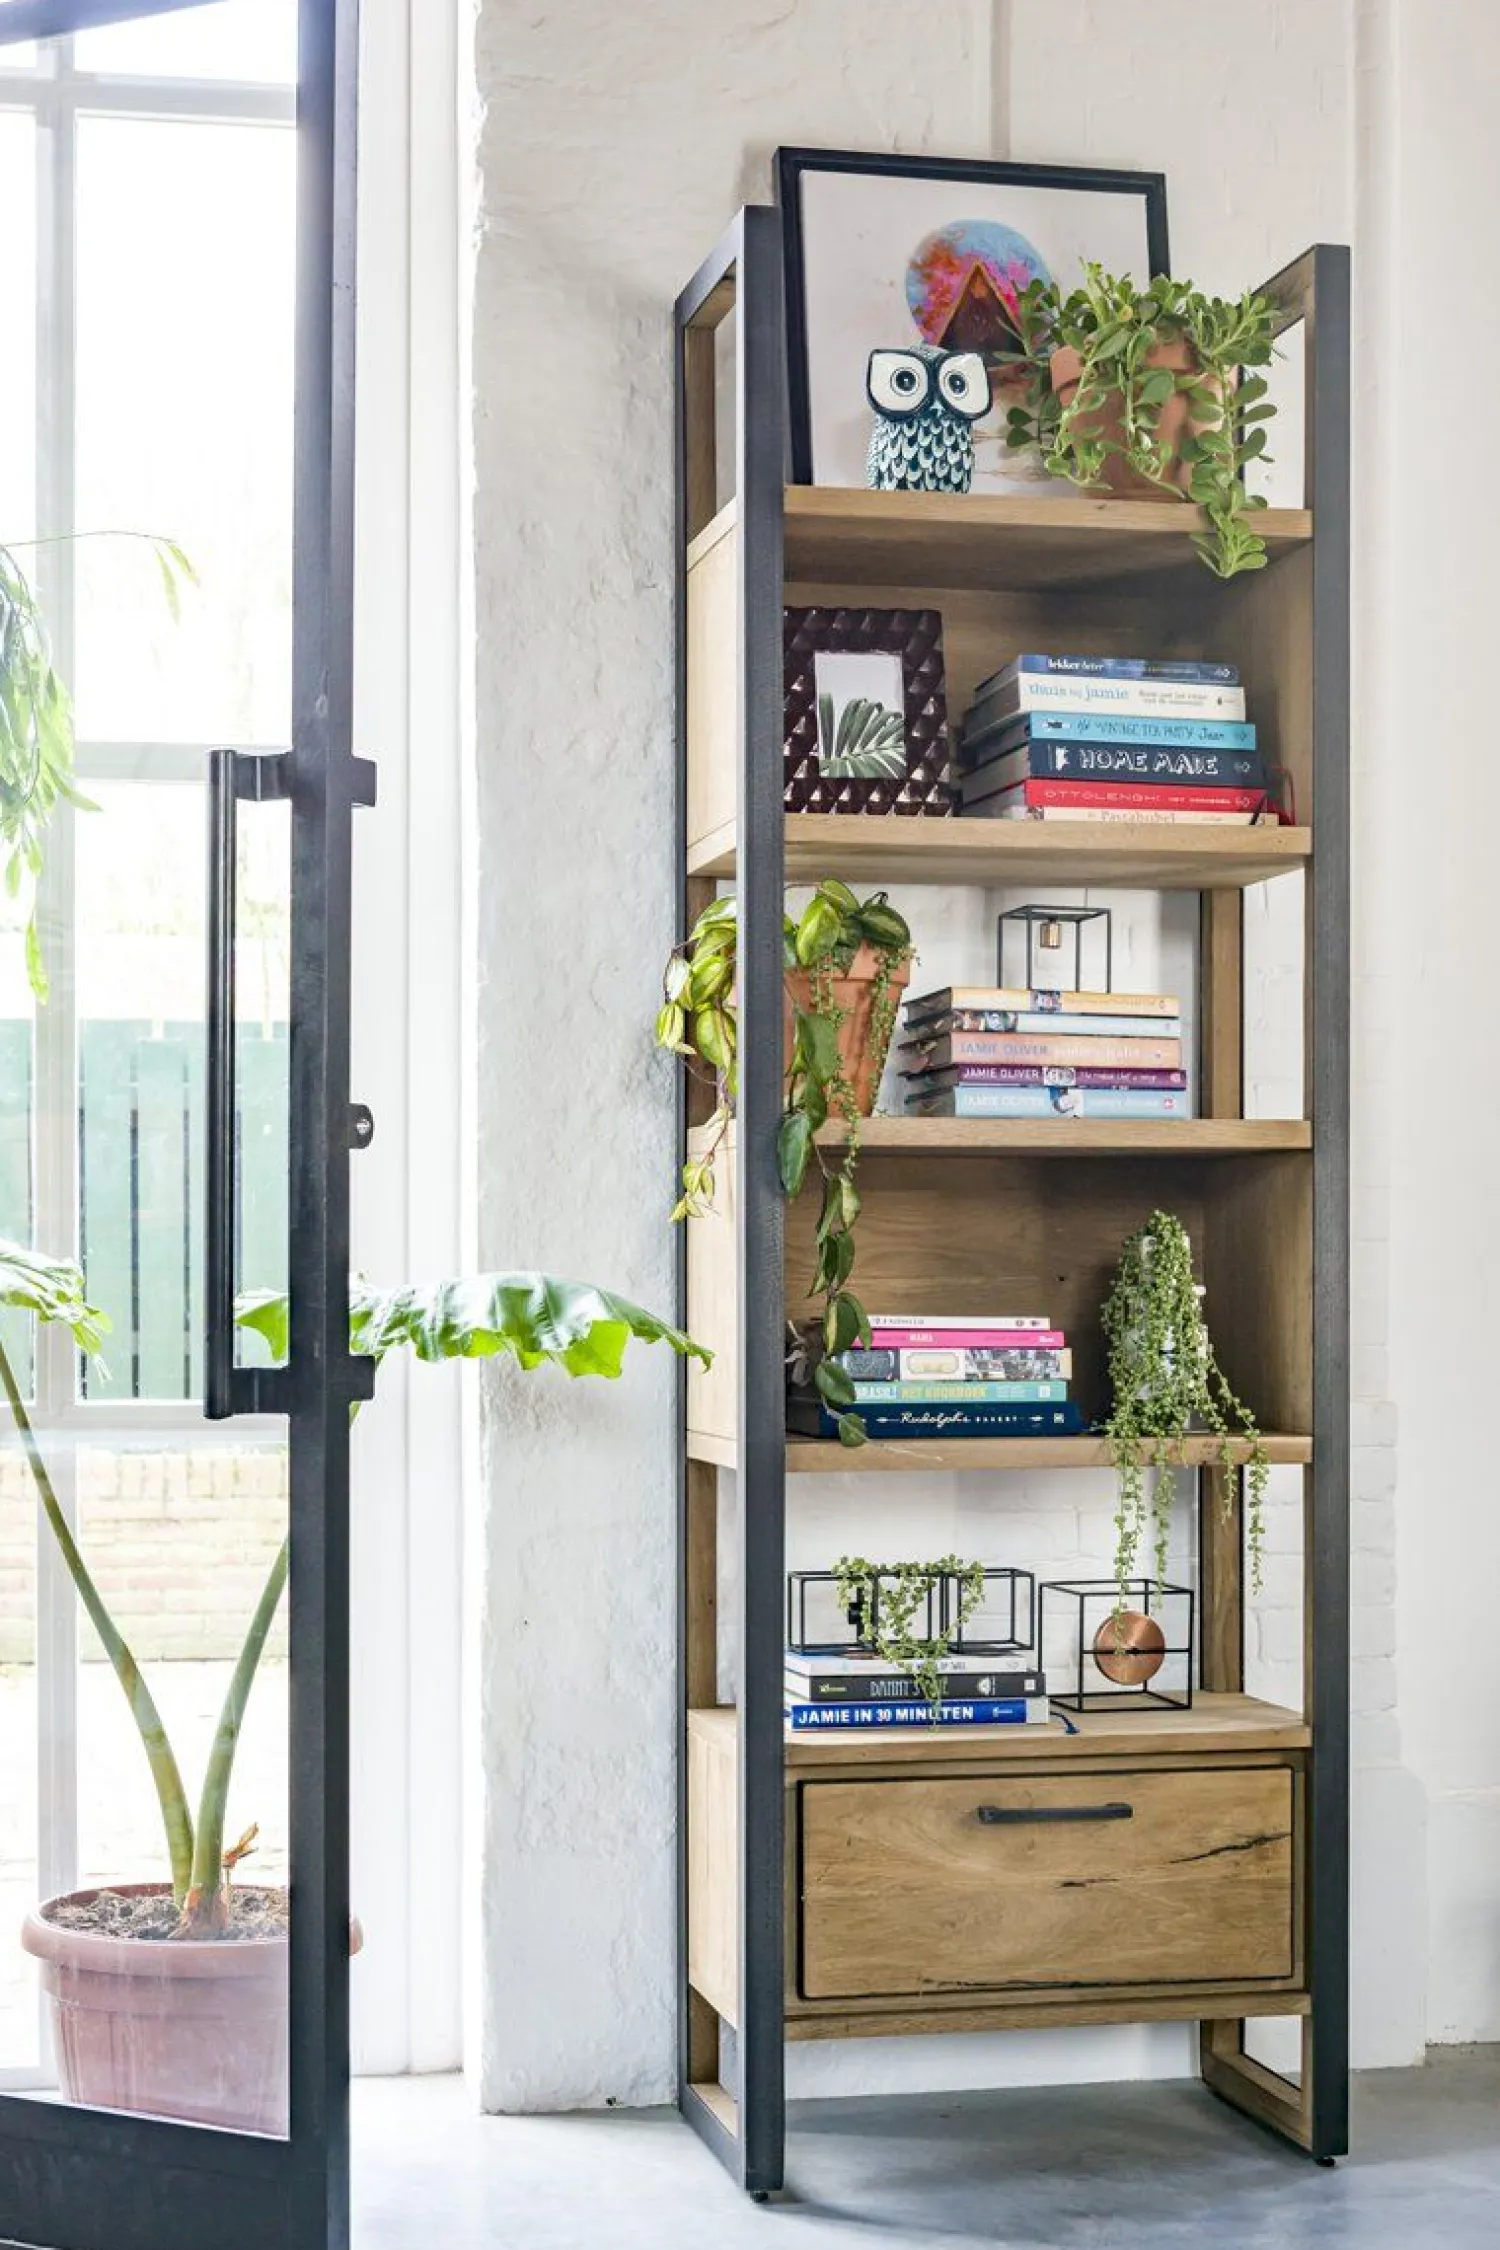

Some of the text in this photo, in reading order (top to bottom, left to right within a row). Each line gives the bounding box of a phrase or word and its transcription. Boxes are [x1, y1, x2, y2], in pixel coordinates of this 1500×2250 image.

[1084, 685, 1129, 701] jamie
[1079, 747, 1147, 773] HOME
[1044, 789, 1161, 803] OTTOLENGHI
[963, 1066, 1040, 1080] JAMIE OLIVER
[798, 1709, 850, 1724] JAMIE
[854, 1708, 873, 1722] IN
[876, 1708, 893, 1722] 30
